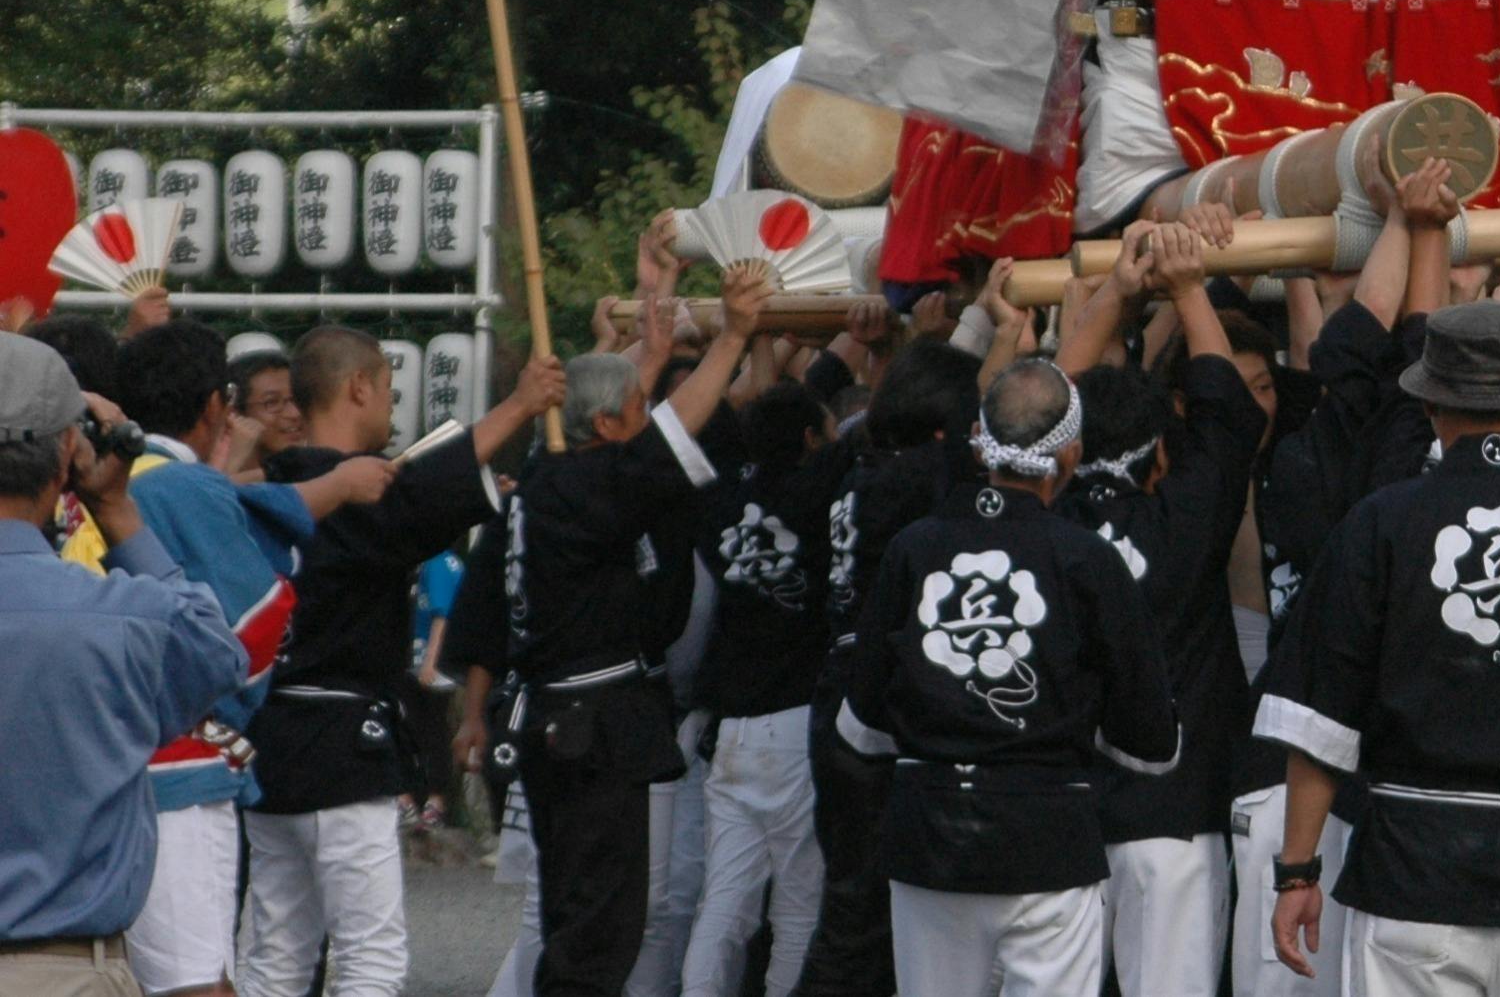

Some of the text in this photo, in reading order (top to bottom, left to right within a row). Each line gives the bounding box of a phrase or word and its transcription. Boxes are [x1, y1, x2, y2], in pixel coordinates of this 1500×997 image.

[229, 168, 261, 257] 御神燈
[299, 167, 330, 251] 御神燈
[368, 168, 400, 256] 御神燈
[427, 166, 459, 251] 御神燈
[939, 578, 1012, 649] 兵
